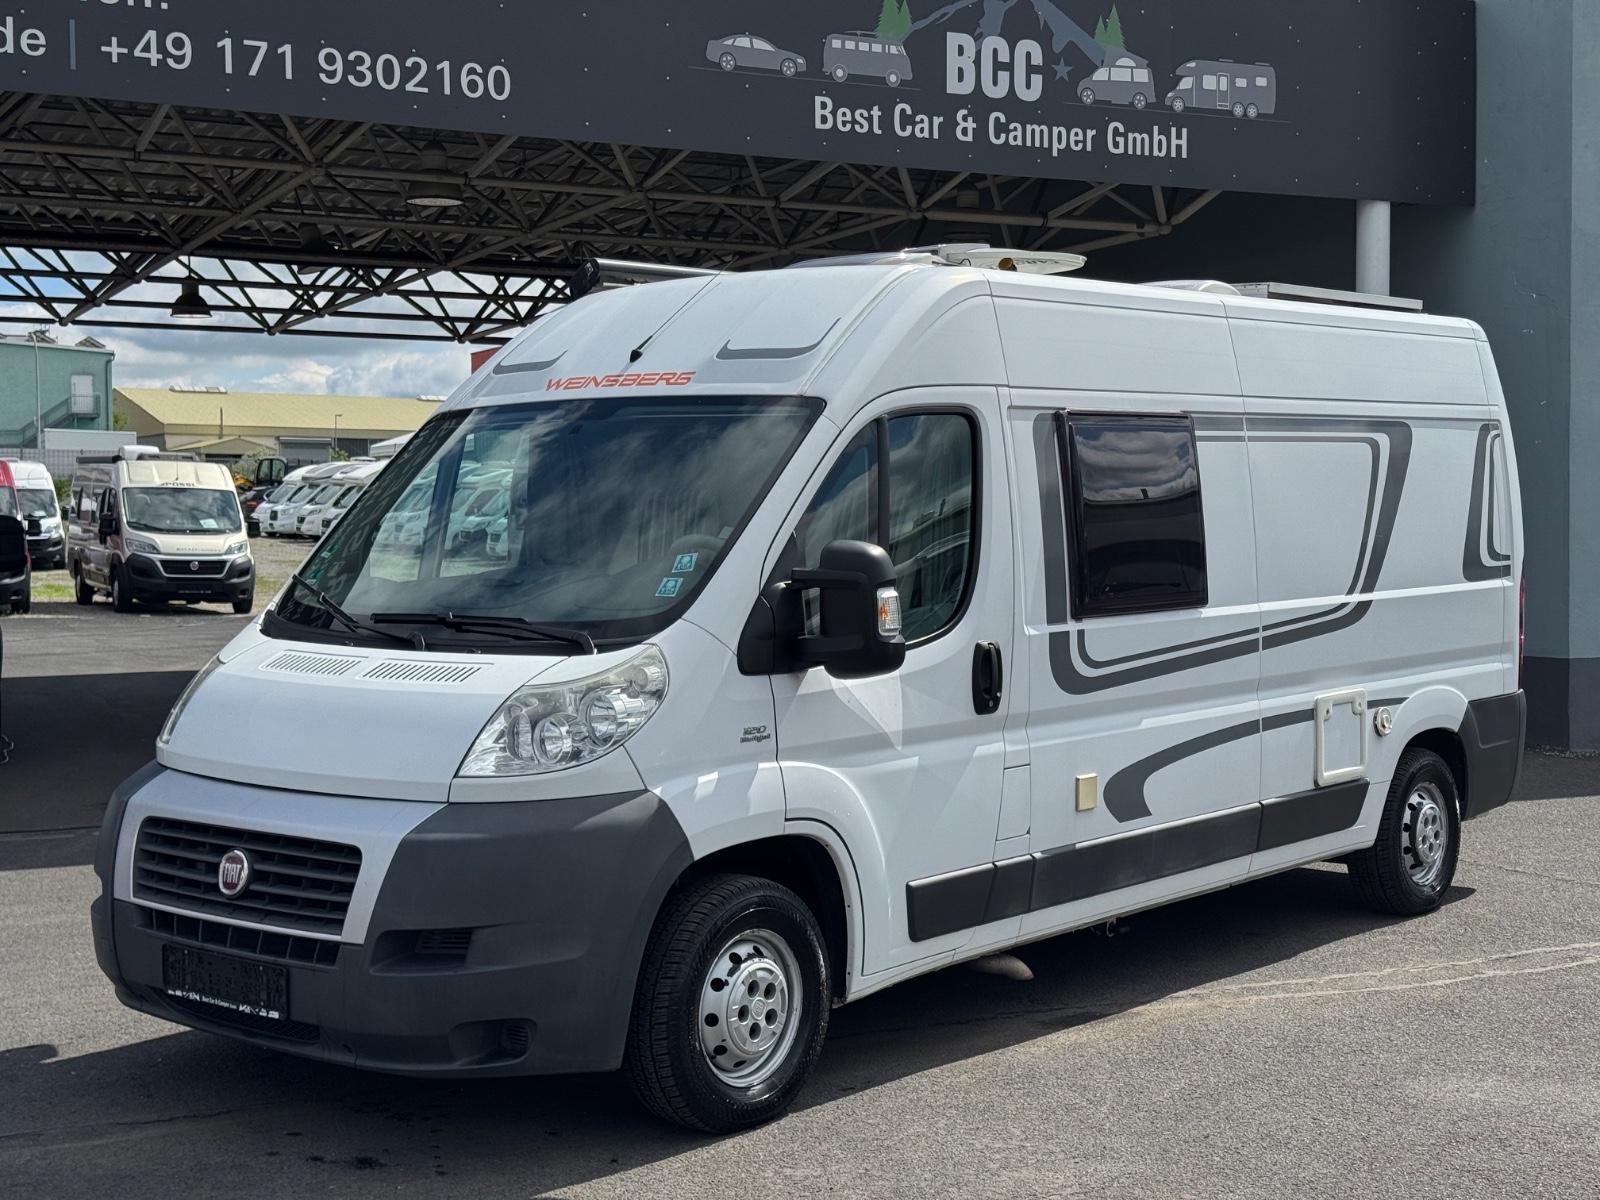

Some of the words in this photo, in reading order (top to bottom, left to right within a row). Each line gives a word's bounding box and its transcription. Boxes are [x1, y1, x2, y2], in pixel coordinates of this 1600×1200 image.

[100, 30, 193, 70] +49
[216, 37, 293, 80] 171
[317, 47, 511, 101] 9302160
[946, 31, 1043, 102] BCC
[814, 95, 882, 135] Best
[893, 102, 944, 140] Car
[955, 108, 977, 142] &
[988, 111, 1097, 157] Camper
[1107, 121, 1188, 159] GmbH
[545, 371, 697, 391] WEINSBERG
[223, 862, 242, 884] FIAT
